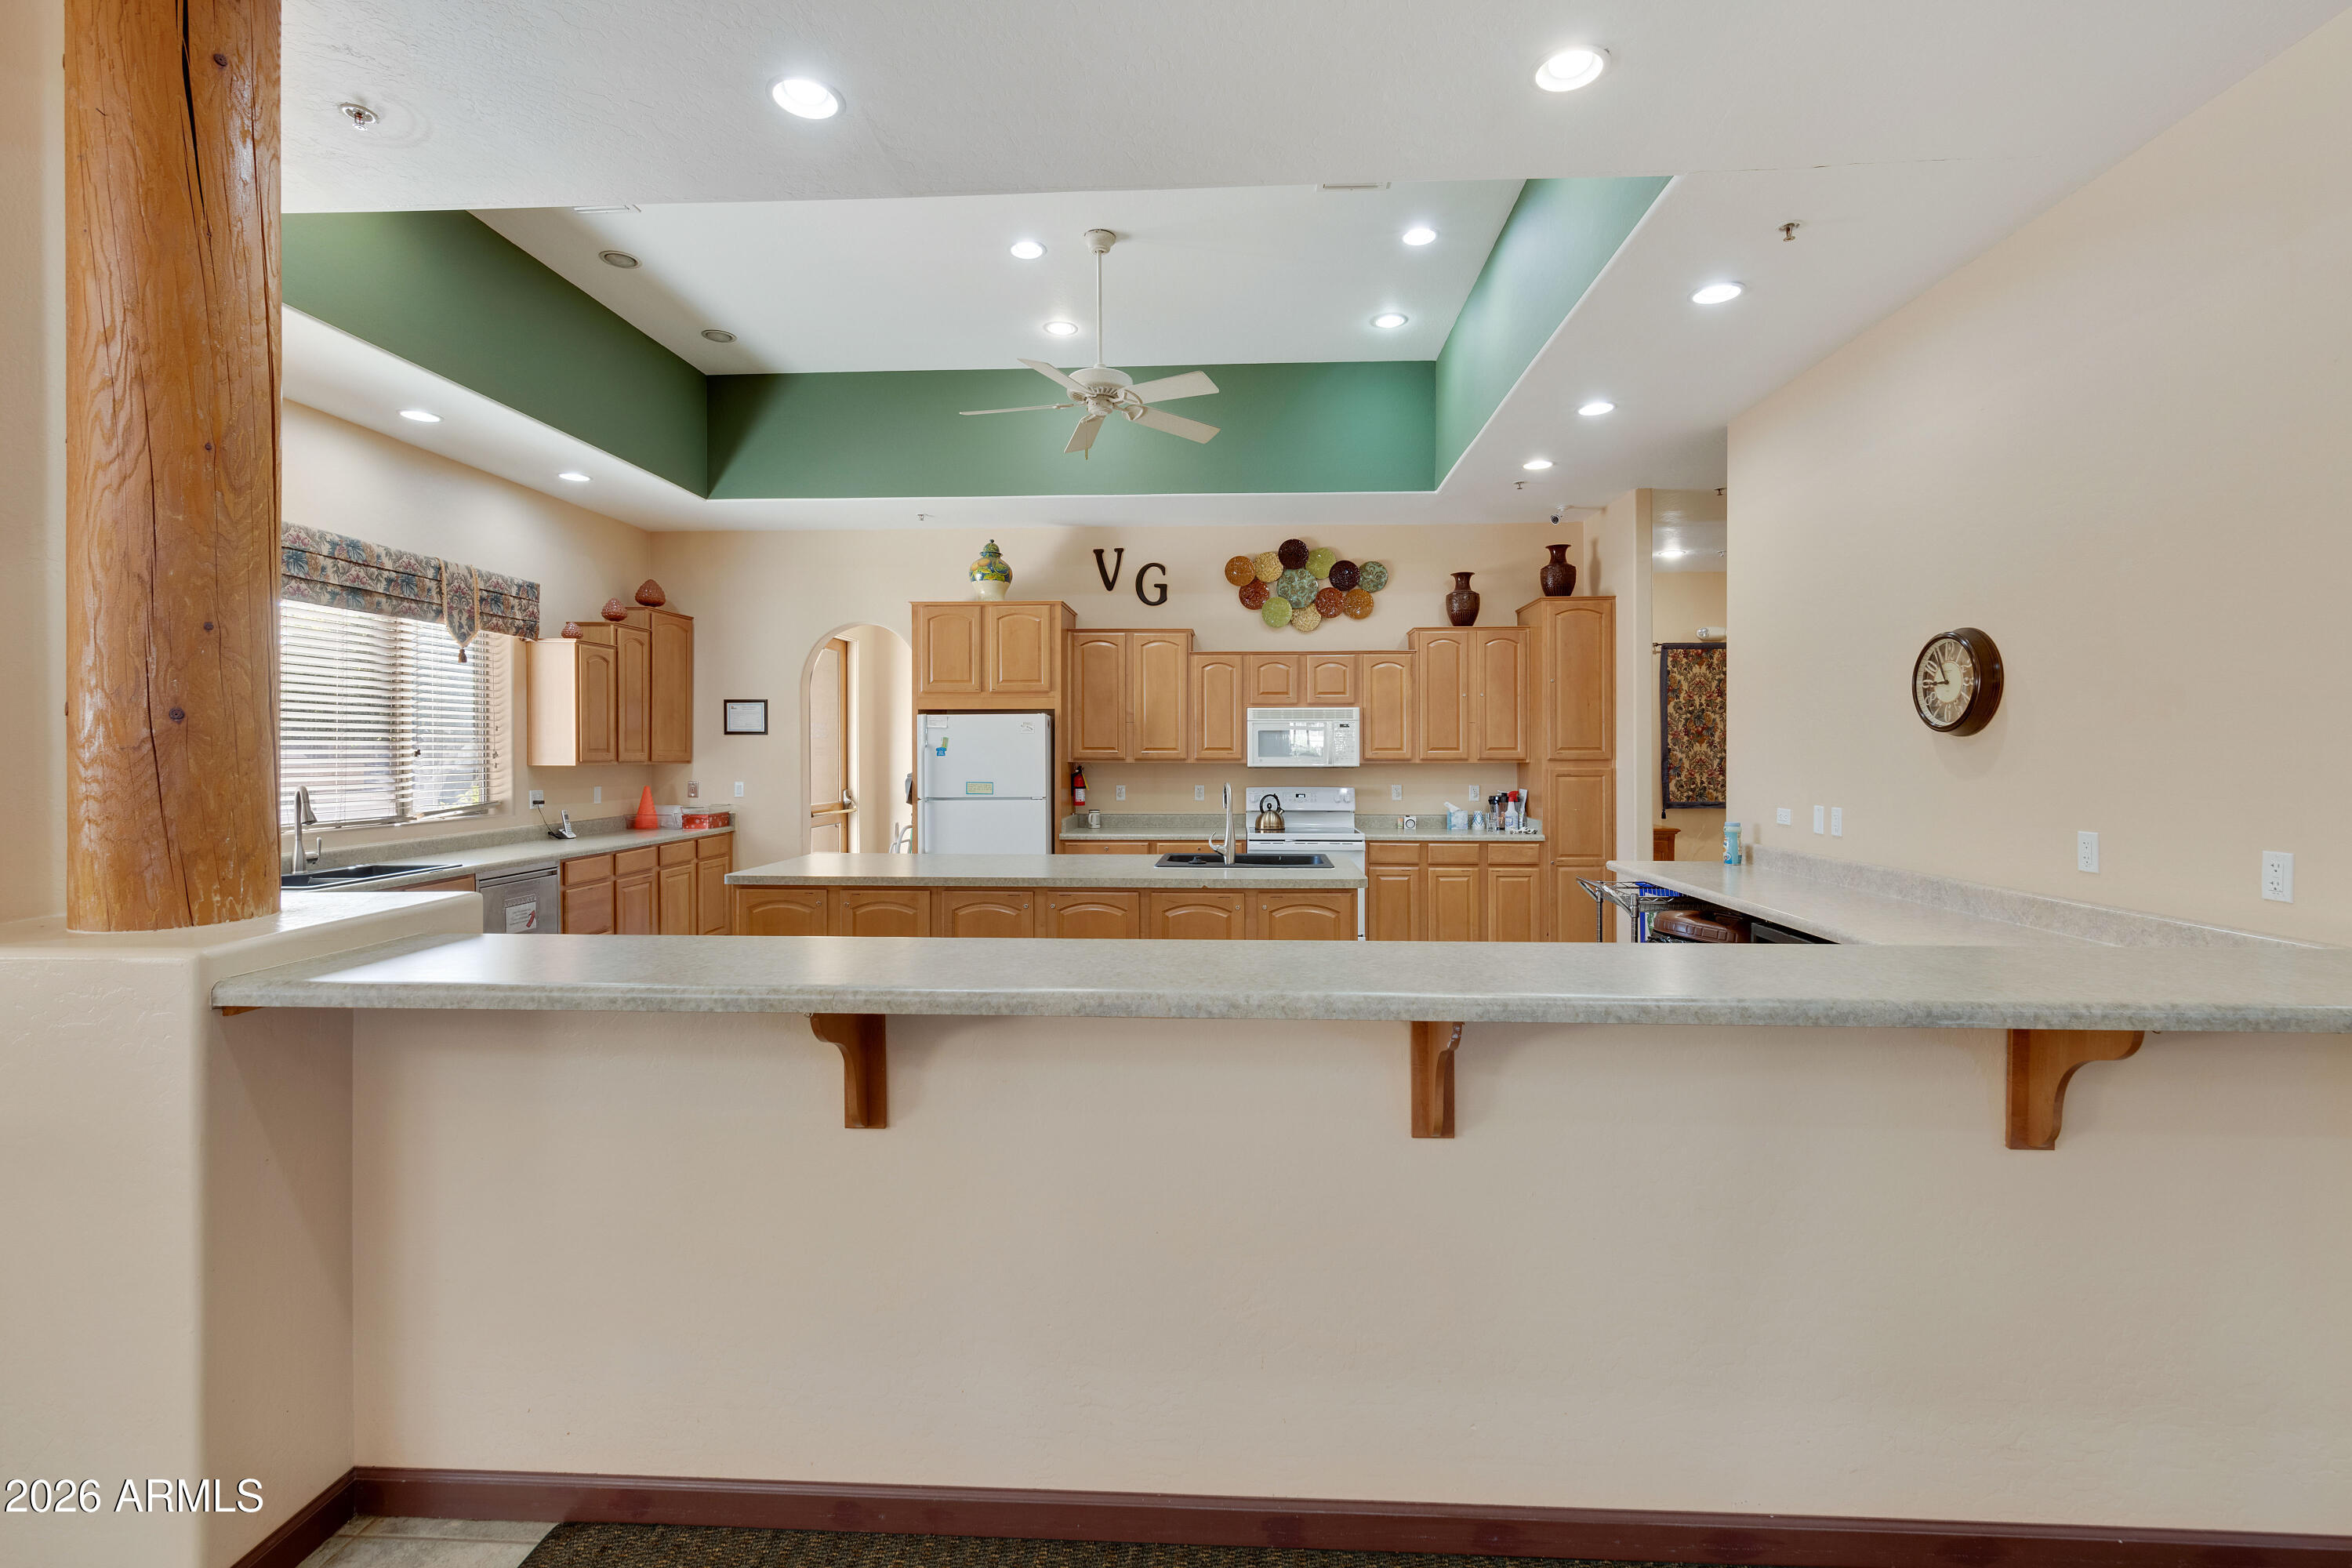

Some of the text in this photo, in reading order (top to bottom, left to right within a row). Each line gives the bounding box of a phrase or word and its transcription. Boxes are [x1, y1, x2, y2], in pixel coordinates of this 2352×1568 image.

[1093, 548, 1167, 606] V G
[1925, 660, 1937, 677] 10
[1926, 691, 1936, 706] 8
